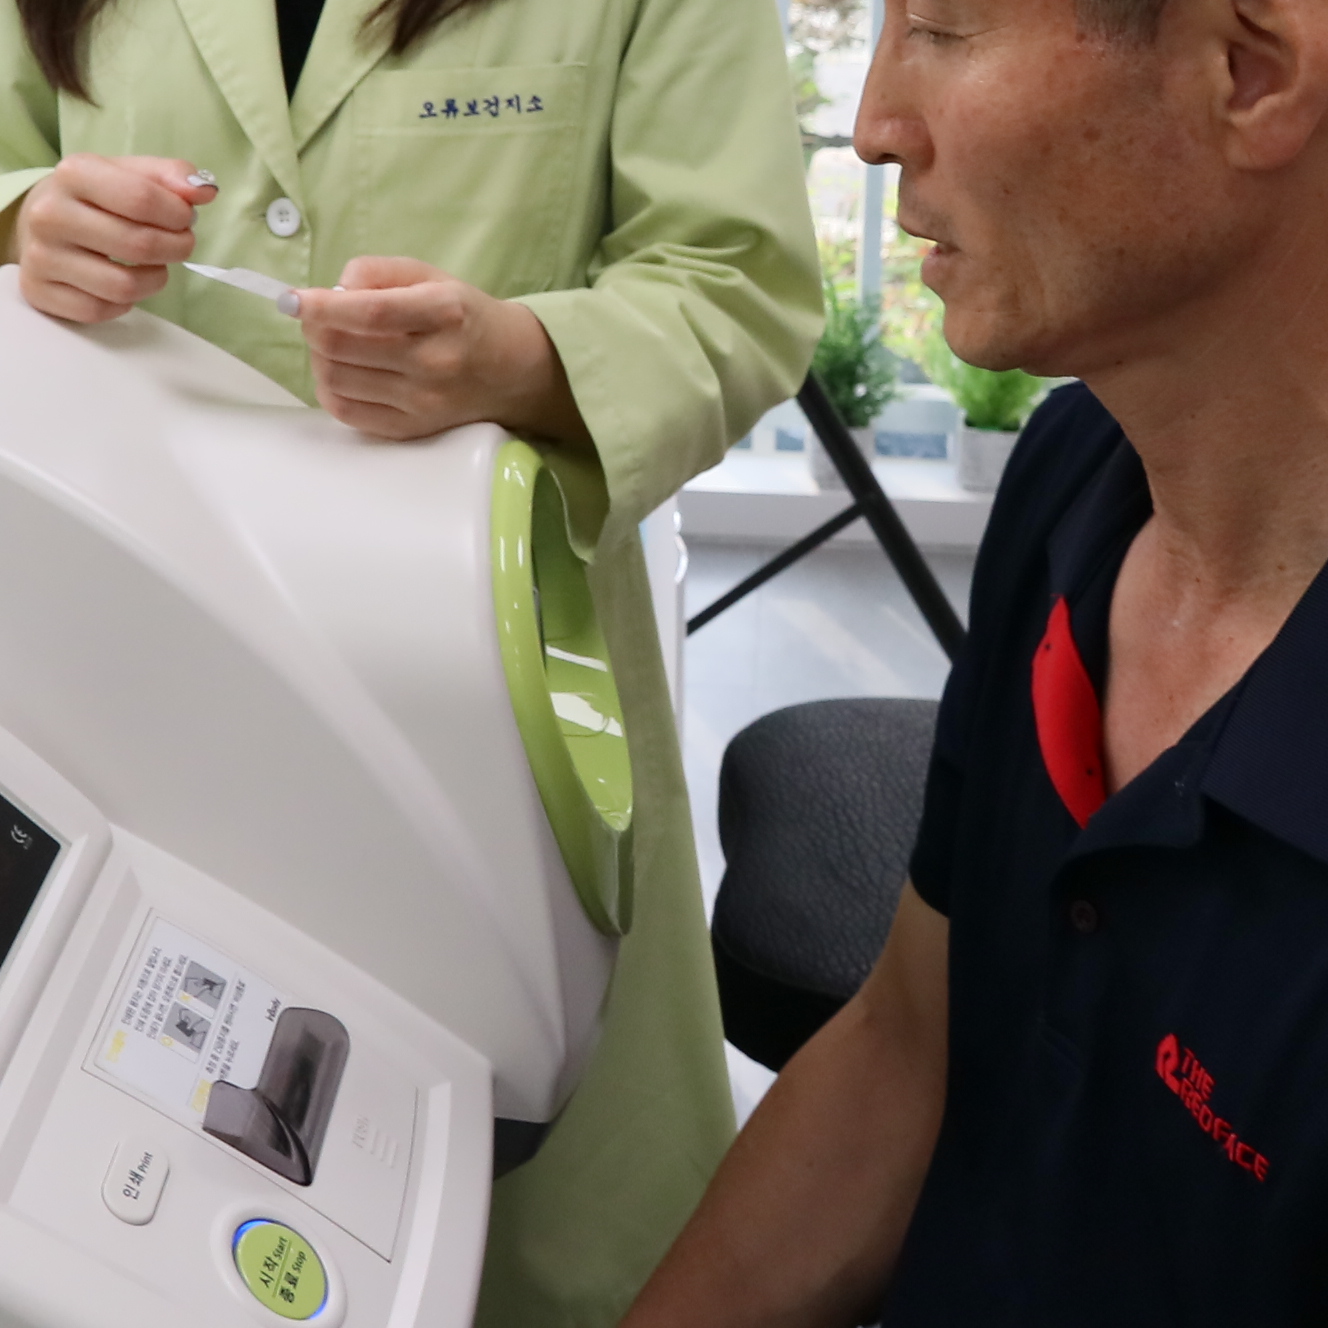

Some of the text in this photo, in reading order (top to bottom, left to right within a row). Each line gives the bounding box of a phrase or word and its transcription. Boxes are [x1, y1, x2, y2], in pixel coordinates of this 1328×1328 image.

[419, 93, 545, 119] 오류보건지소
[1182, 1047, 1216, 1101] THE
[123, 1151, 153, 1200] 인쇄 Print
[259, 1236, 288, 1288] 시작 Start
[292, 1251, 307, 1274] Stop
